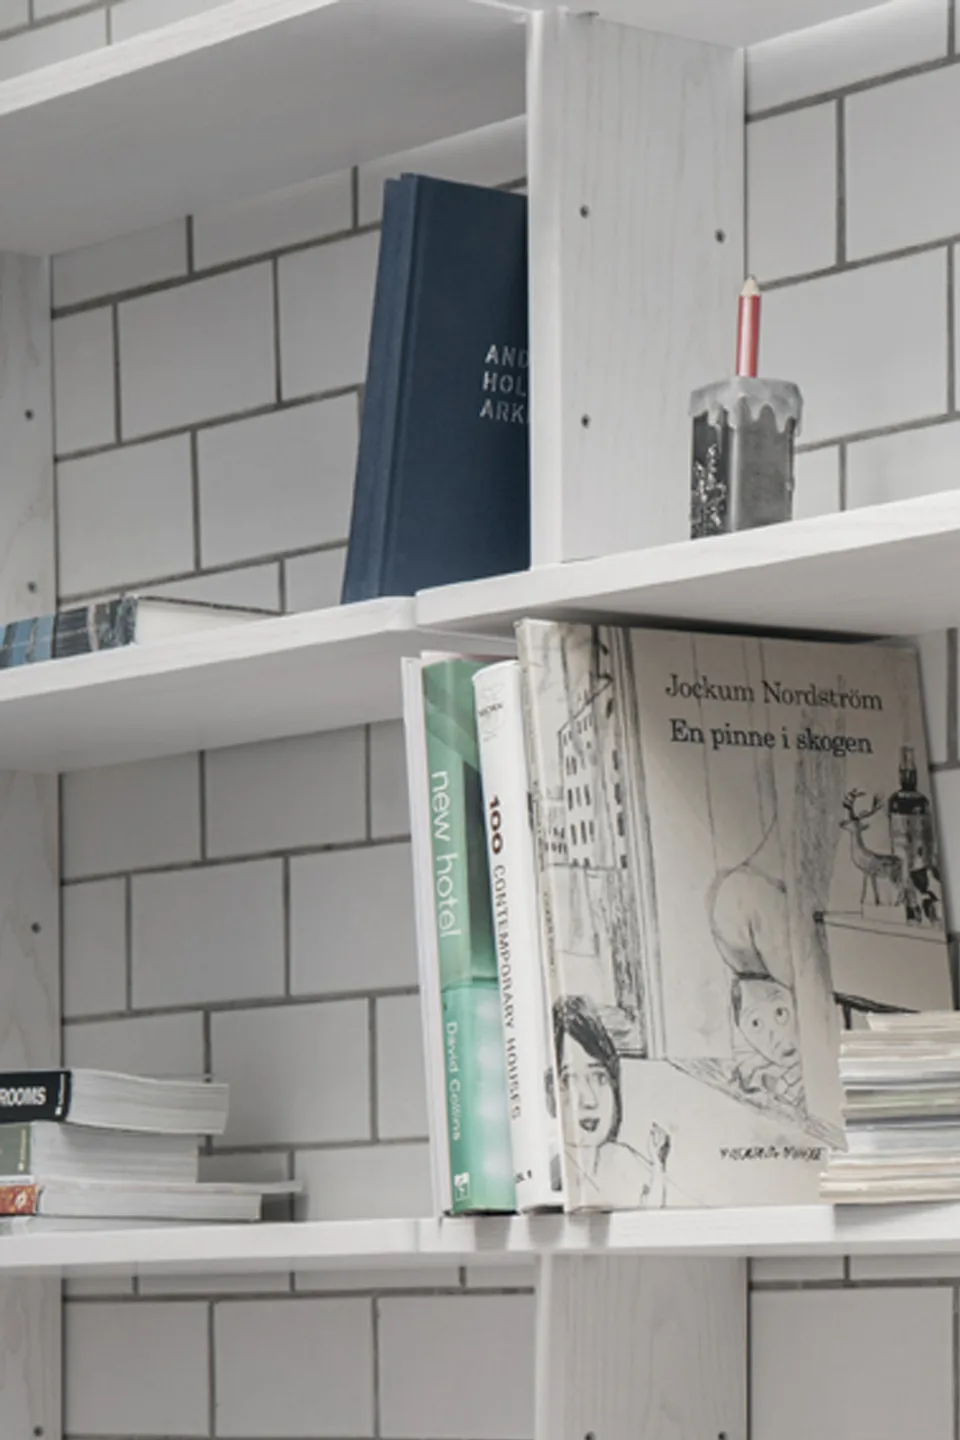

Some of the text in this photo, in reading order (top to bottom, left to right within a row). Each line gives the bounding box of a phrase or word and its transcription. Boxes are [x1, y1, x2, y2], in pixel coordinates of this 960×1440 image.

[665, 673, 883, 711] Jockum Nordström
[669, 718, 873, 757] En pinne i skogen
[431, 770, 461, 938] new hotel
[488, 794, 520, 1119] 100 CONTEMPORARY HOUSES
[445, 1021, 459, 1073] David
